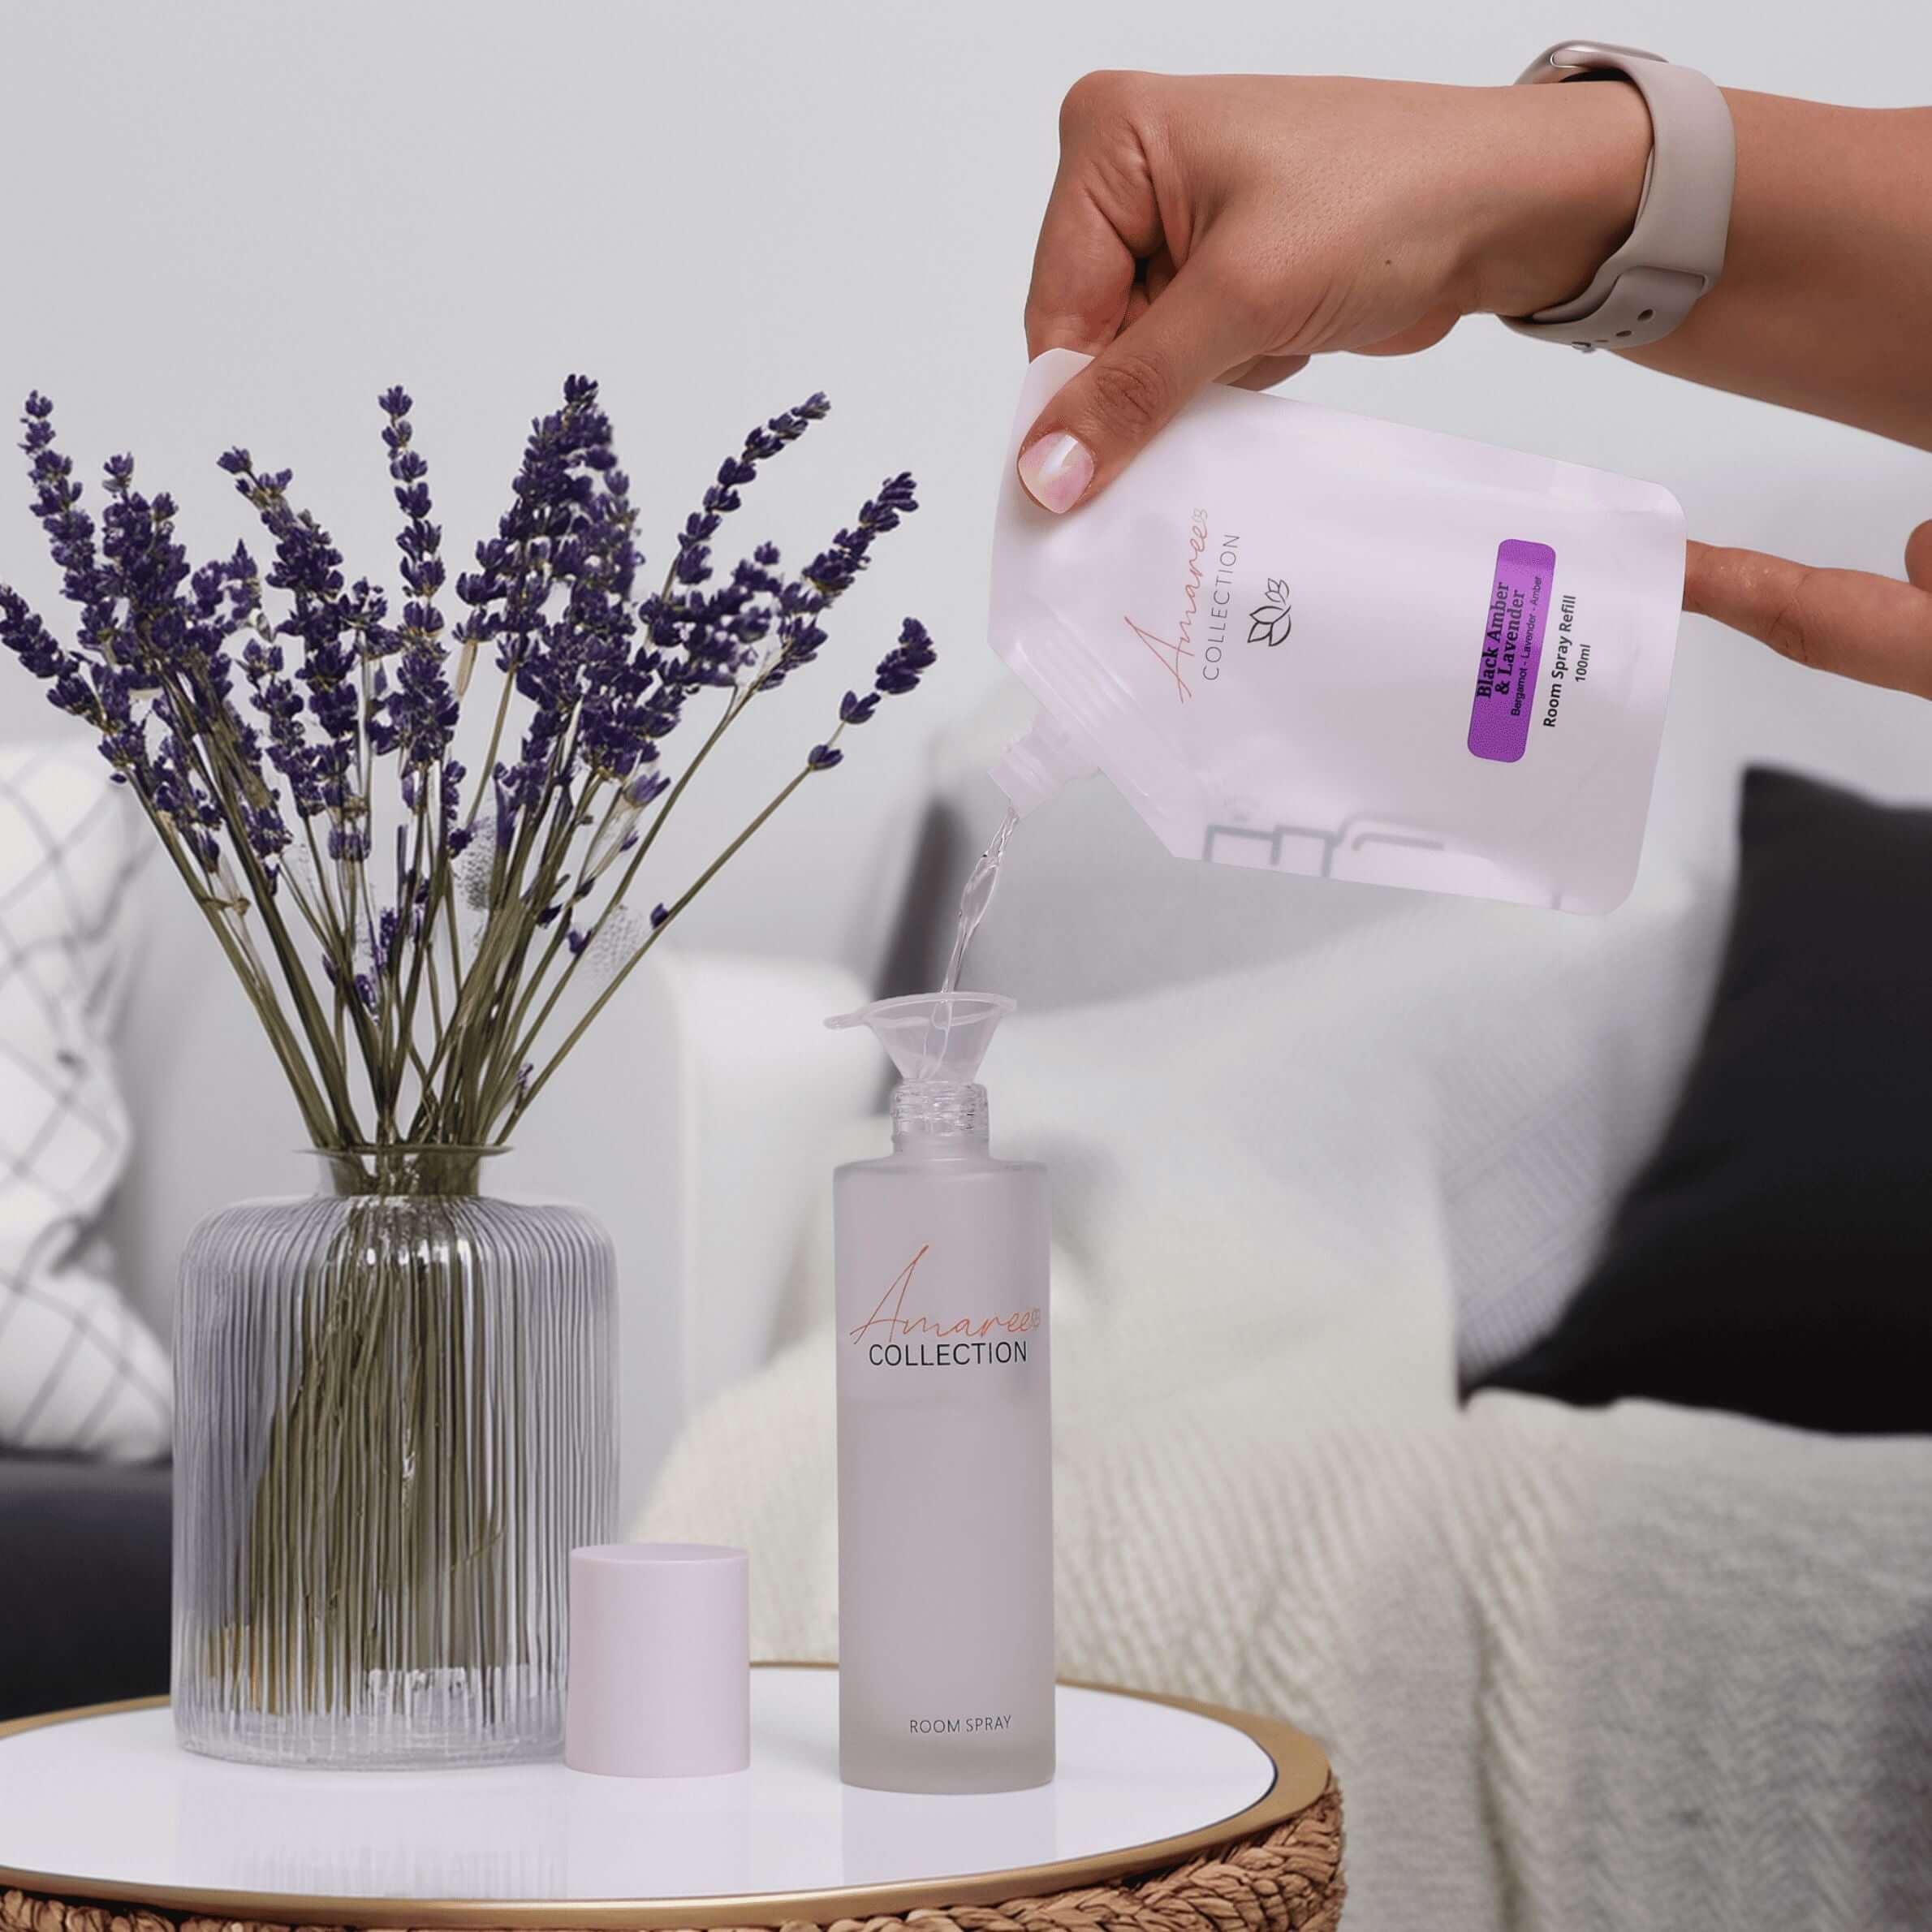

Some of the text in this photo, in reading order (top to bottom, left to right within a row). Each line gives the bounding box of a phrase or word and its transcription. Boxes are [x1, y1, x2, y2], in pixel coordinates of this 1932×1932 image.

[1202, 534, 1240, 681] COLLECTION
[1476, 582, 1509, 699] Black Amber
[1494, 589, 1524, 696] & Lavender
[1511, 666, 1529, 716] Bergamot
[1520, 613, 1537, 659] Lavender
[1530, 576, 1542, 606] Amber
[1543, 594, 1577, 727] Room Spray Refill
[1576, 643, 1591, 682] 100ml
[869, 1340, 1028, 1366] COLLECTION
[909, 1714, 1011, 1735] ROOM SPRAY
